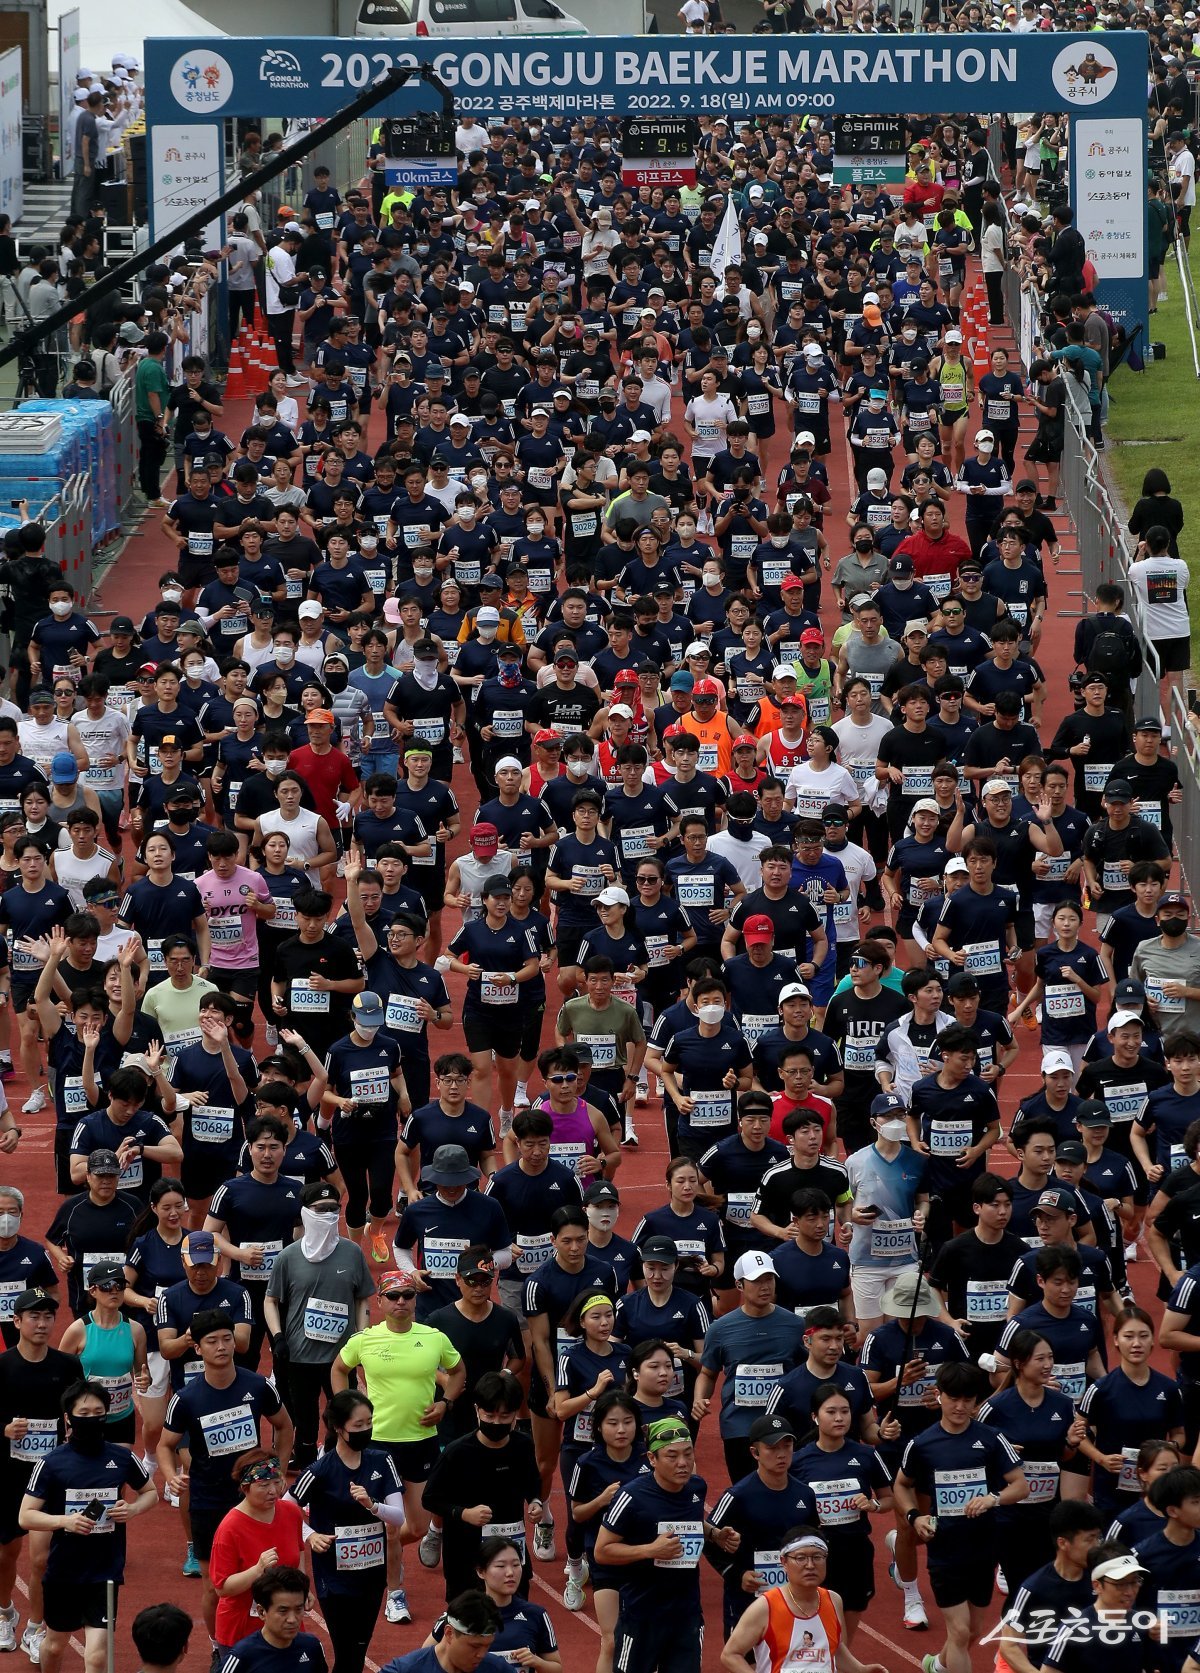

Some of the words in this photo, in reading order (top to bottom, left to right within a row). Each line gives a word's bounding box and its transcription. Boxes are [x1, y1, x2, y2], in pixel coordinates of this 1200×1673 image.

[433, 52, 603, 88] GONGJU
[616, 50, 766, 84] BAEKJE
[778, 48, 1017, 84] MARATHON
[186, 91, 220, 102] 충청남도
[1067, 86, 1098, 98] 공주시
[454, 96, 494, 110] 2022
[498, 95, 616, 111] 공주백제마라톤
[628, 95, 675, 109] 2022.
[680, 95, 694, 108] 9.
[701, 93, 750, 110] 18(일)
[754, 94, 782, 108] AM
[786, 94, 834, 108] 09:00
[641, 125, 686, 134] SAMIK
[854, 123, 898, 131] SAMIK
[1108, 146, 1130, 154] 공주시
[184, 152, 206, 160] 공주시
[396, 171, 453, 183] 10km코스
[636, 172, 683, 184] 하프코스
[852, 168, 886, 181] 풀코스
[1098, 170, 1132, 178] 동아일보
[1106, 232, 1131, 240] 충청남도
[749, 401, 769, 410] 35395
[529, 475, 550, 483] 35309
[869, 513, 892, 521] 35334
[405, 533, 421, 543] 307
[190, 541, 213, 550] 30727
[455, 570, 480, 579] 30132
[765, 571, 790, 580] 3081
[529, 577, 550, 587] 5211
[927, 583, 950, 592] 0543
[223, 619, 247, 628] 30679
[782, 653, 801, 662] 3046
[737, 687, 766, 696] 35325
[494, 722, 522, 730] 30260
[415, 729, 443, 738] 30111
[701, 756, 717, 764] 791
[85, 769, 114, 777] 30911
[905, 778, 933, 787] 30092
[1140, 814, 1158, 823] 071
[625, 840, 647, 850] 3062
[1050, 864, 1068, 873] 615
[1105, 873, 1128, 883] 3118
[584, 879, 604, 888] 031
[681, 889, 712, 898] 30953
[275, 911, 295, 920] 501
[833, 907, 849, 916] 481
[210, 930, 240, 939] 30170
[966, 956, 998, 968] 30831
[484, 986, 516, 996] 35102
[294, 993, 327, 1003] 30835
[1049, 998, 1081, 1009] 35373
[592, 1049, 613, 1059] 478
[354, 1082, 387, 1095] 35117
[67, 1092, 87, 1103] 303
[692, 1106, 728, 1117] 31156
[1109, 1100, 1138, 1113] 3002
[194, 1120, 230, 1133] 30684
[934, 1136, 969, 1146] 31189
[120, 1166, 139, 1178] 217
[730, 1208, 750, 1218] 300
[875, 1236, 911, 1246] 31054
[427, 1256, 457, 1267] 3020
[756, 1256, 763, 1266] B
[308, 1315, 344, 1333] 30276
[739, 1383, 776, 1395] 3109
[1061, 1381, 1083, 1394] 617
[109, 1391, 129, 1404] 234
[208, 1424, 252, 1445] 30078
[14, 1438, 55, 1450] 30344
[1028, 1480, 1054, 1492] 072
[940, 1488, 984, 1504] 30976
[340, 1540, 381, 1559] 35400
[760, 1569, 789, 1585] 300
